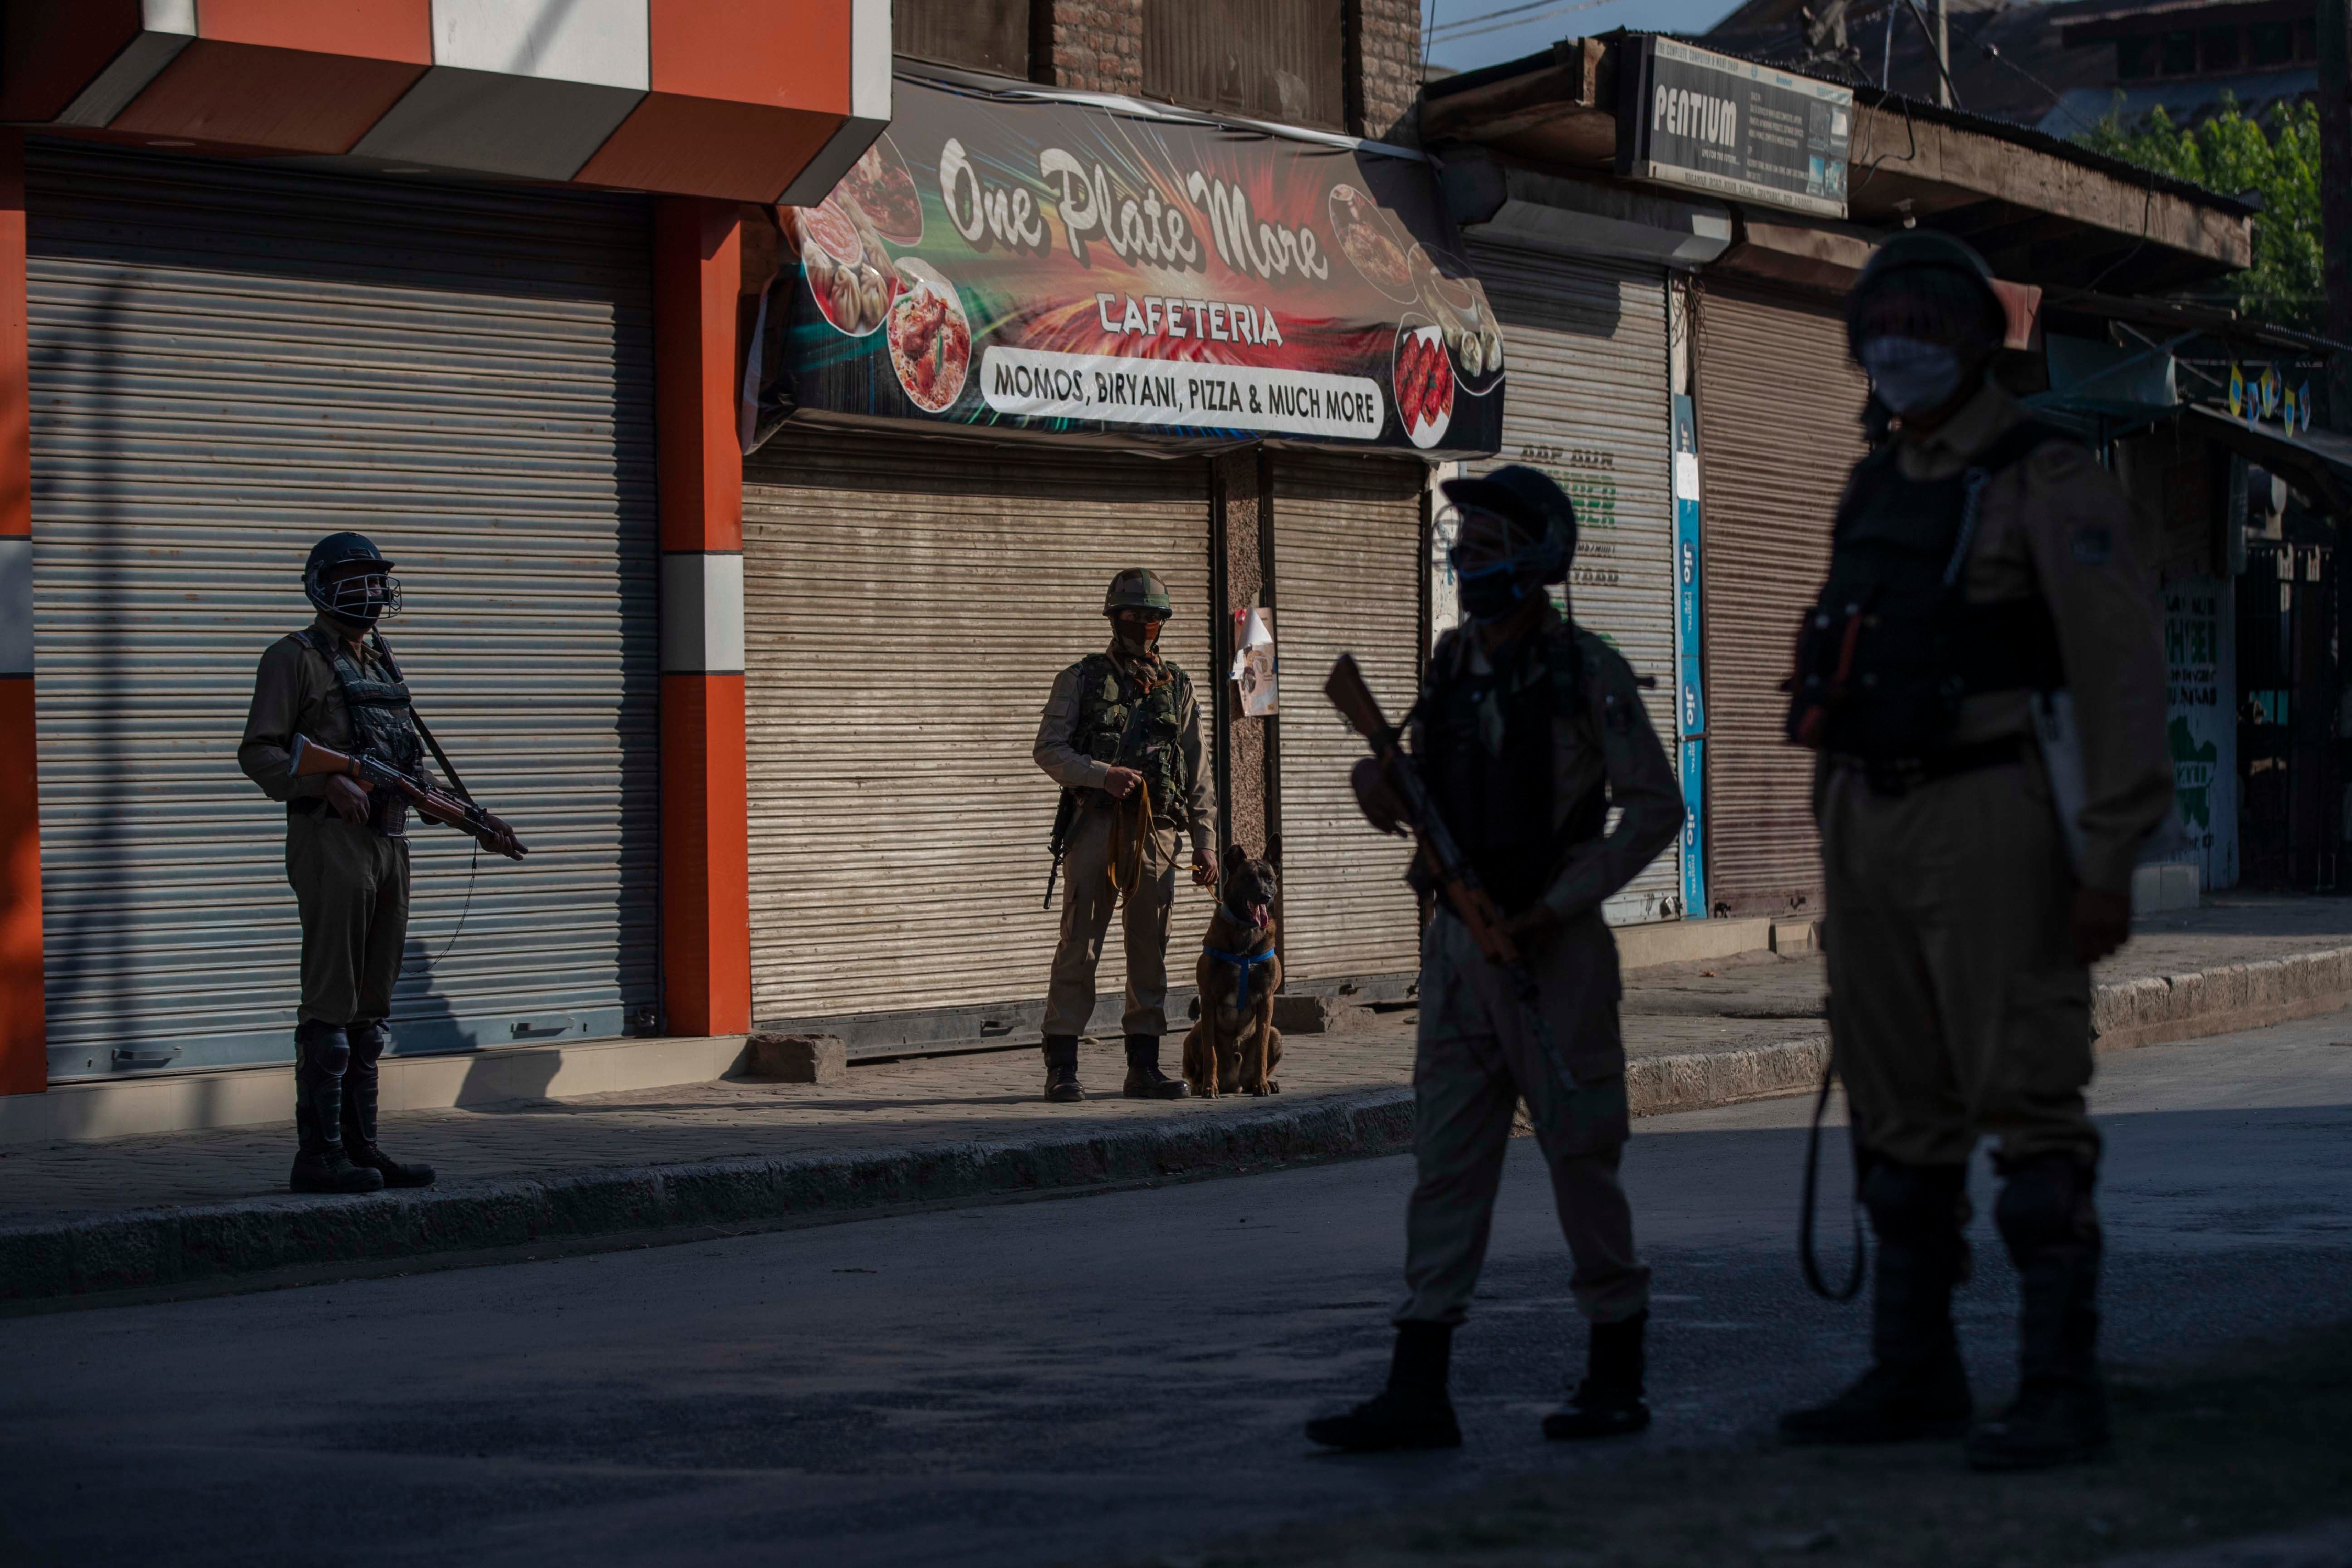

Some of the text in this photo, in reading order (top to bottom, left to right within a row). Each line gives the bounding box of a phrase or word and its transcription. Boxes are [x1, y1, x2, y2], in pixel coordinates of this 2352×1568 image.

[1654, 83, 1738, 147] PENTIUM
[940, 137, 1328, 280] One Plate More
[1095, 291, 1284, 349] CAFETERIA
[994, 363, 1374, 423] MOMOS, BIRYANI, PIZZA & MUCH MORE
[1684, 543, 1693, 583] Jio
[1686, 686, 1695, 725] Jio
[1687, 806, 1695, 846] Jio
